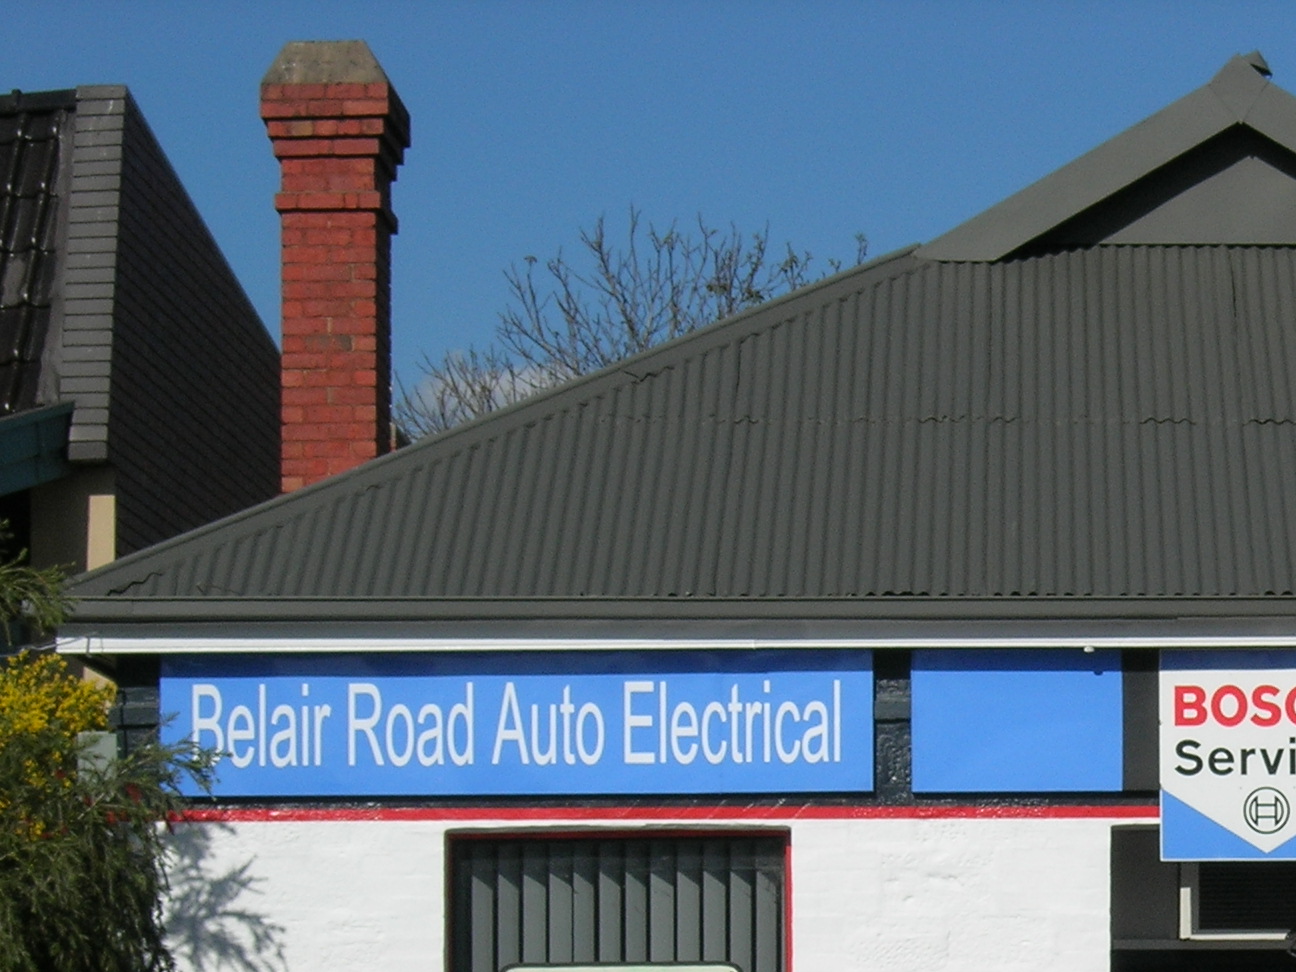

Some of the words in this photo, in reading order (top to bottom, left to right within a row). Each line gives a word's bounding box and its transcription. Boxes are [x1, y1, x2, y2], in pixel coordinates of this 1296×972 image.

[192, 683, 332, 769] Belair
[347, 681, 475, 767] Road
[491, 681, 605, 766] Auto
[623, 679, 842, 765] Electrical
